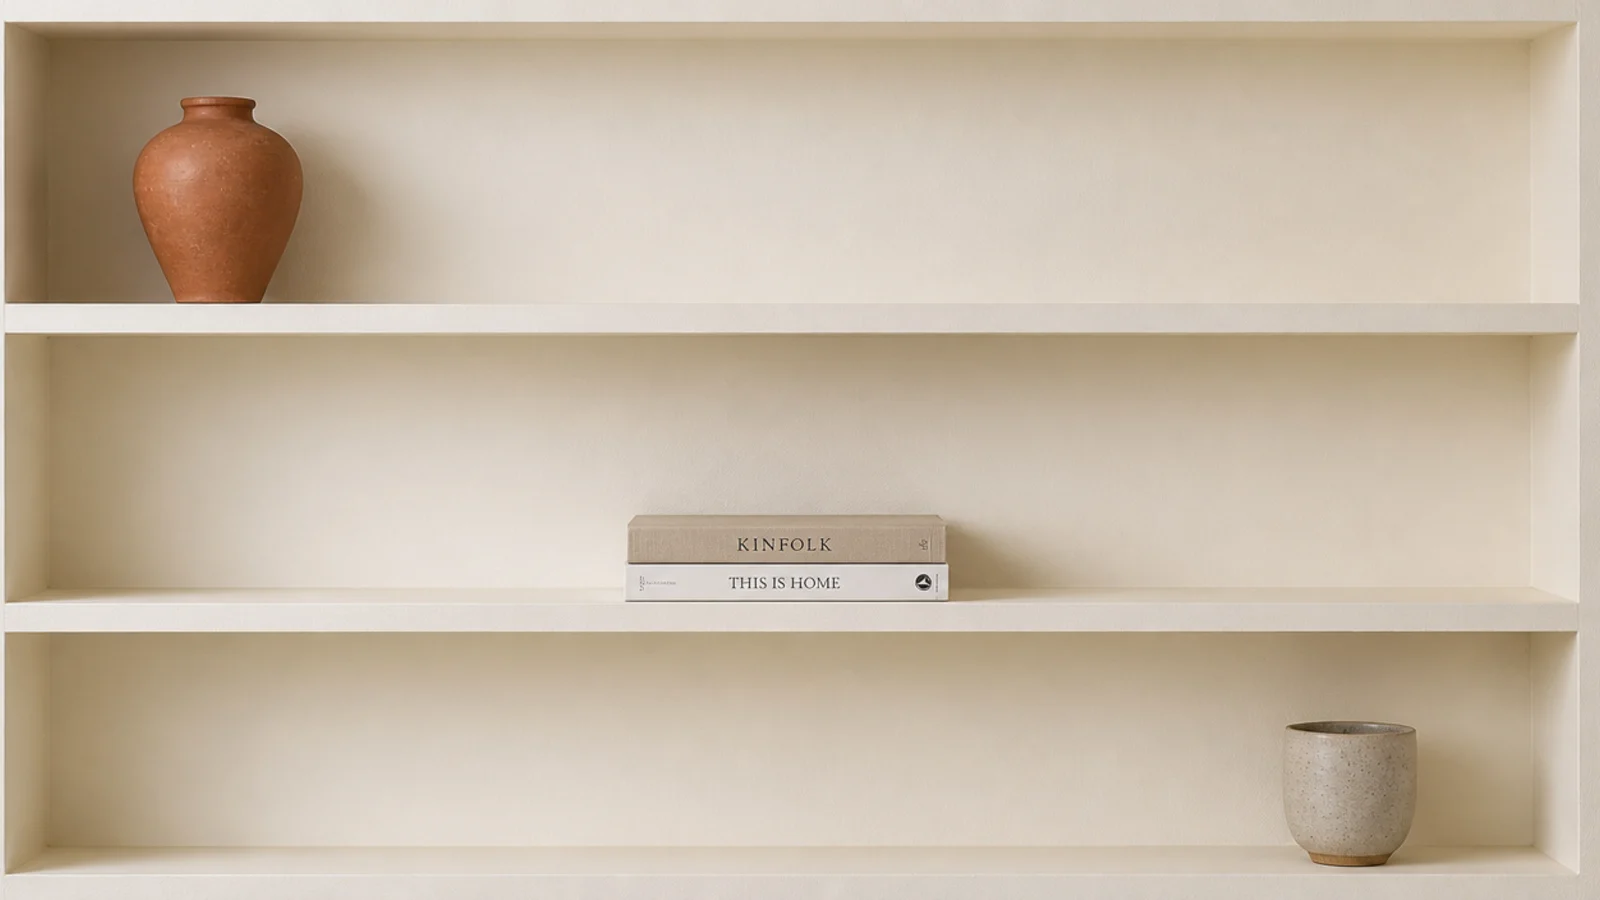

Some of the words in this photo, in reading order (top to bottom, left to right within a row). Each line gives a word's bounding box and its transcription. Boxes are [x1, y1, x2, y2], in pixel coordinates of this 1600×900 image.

[737, 537, 832, 552] KINFOLK
[728, 576, 768, 590] THIS
[772, 576, 786, 590] IS
[790, 576, 841, 590] HOME
